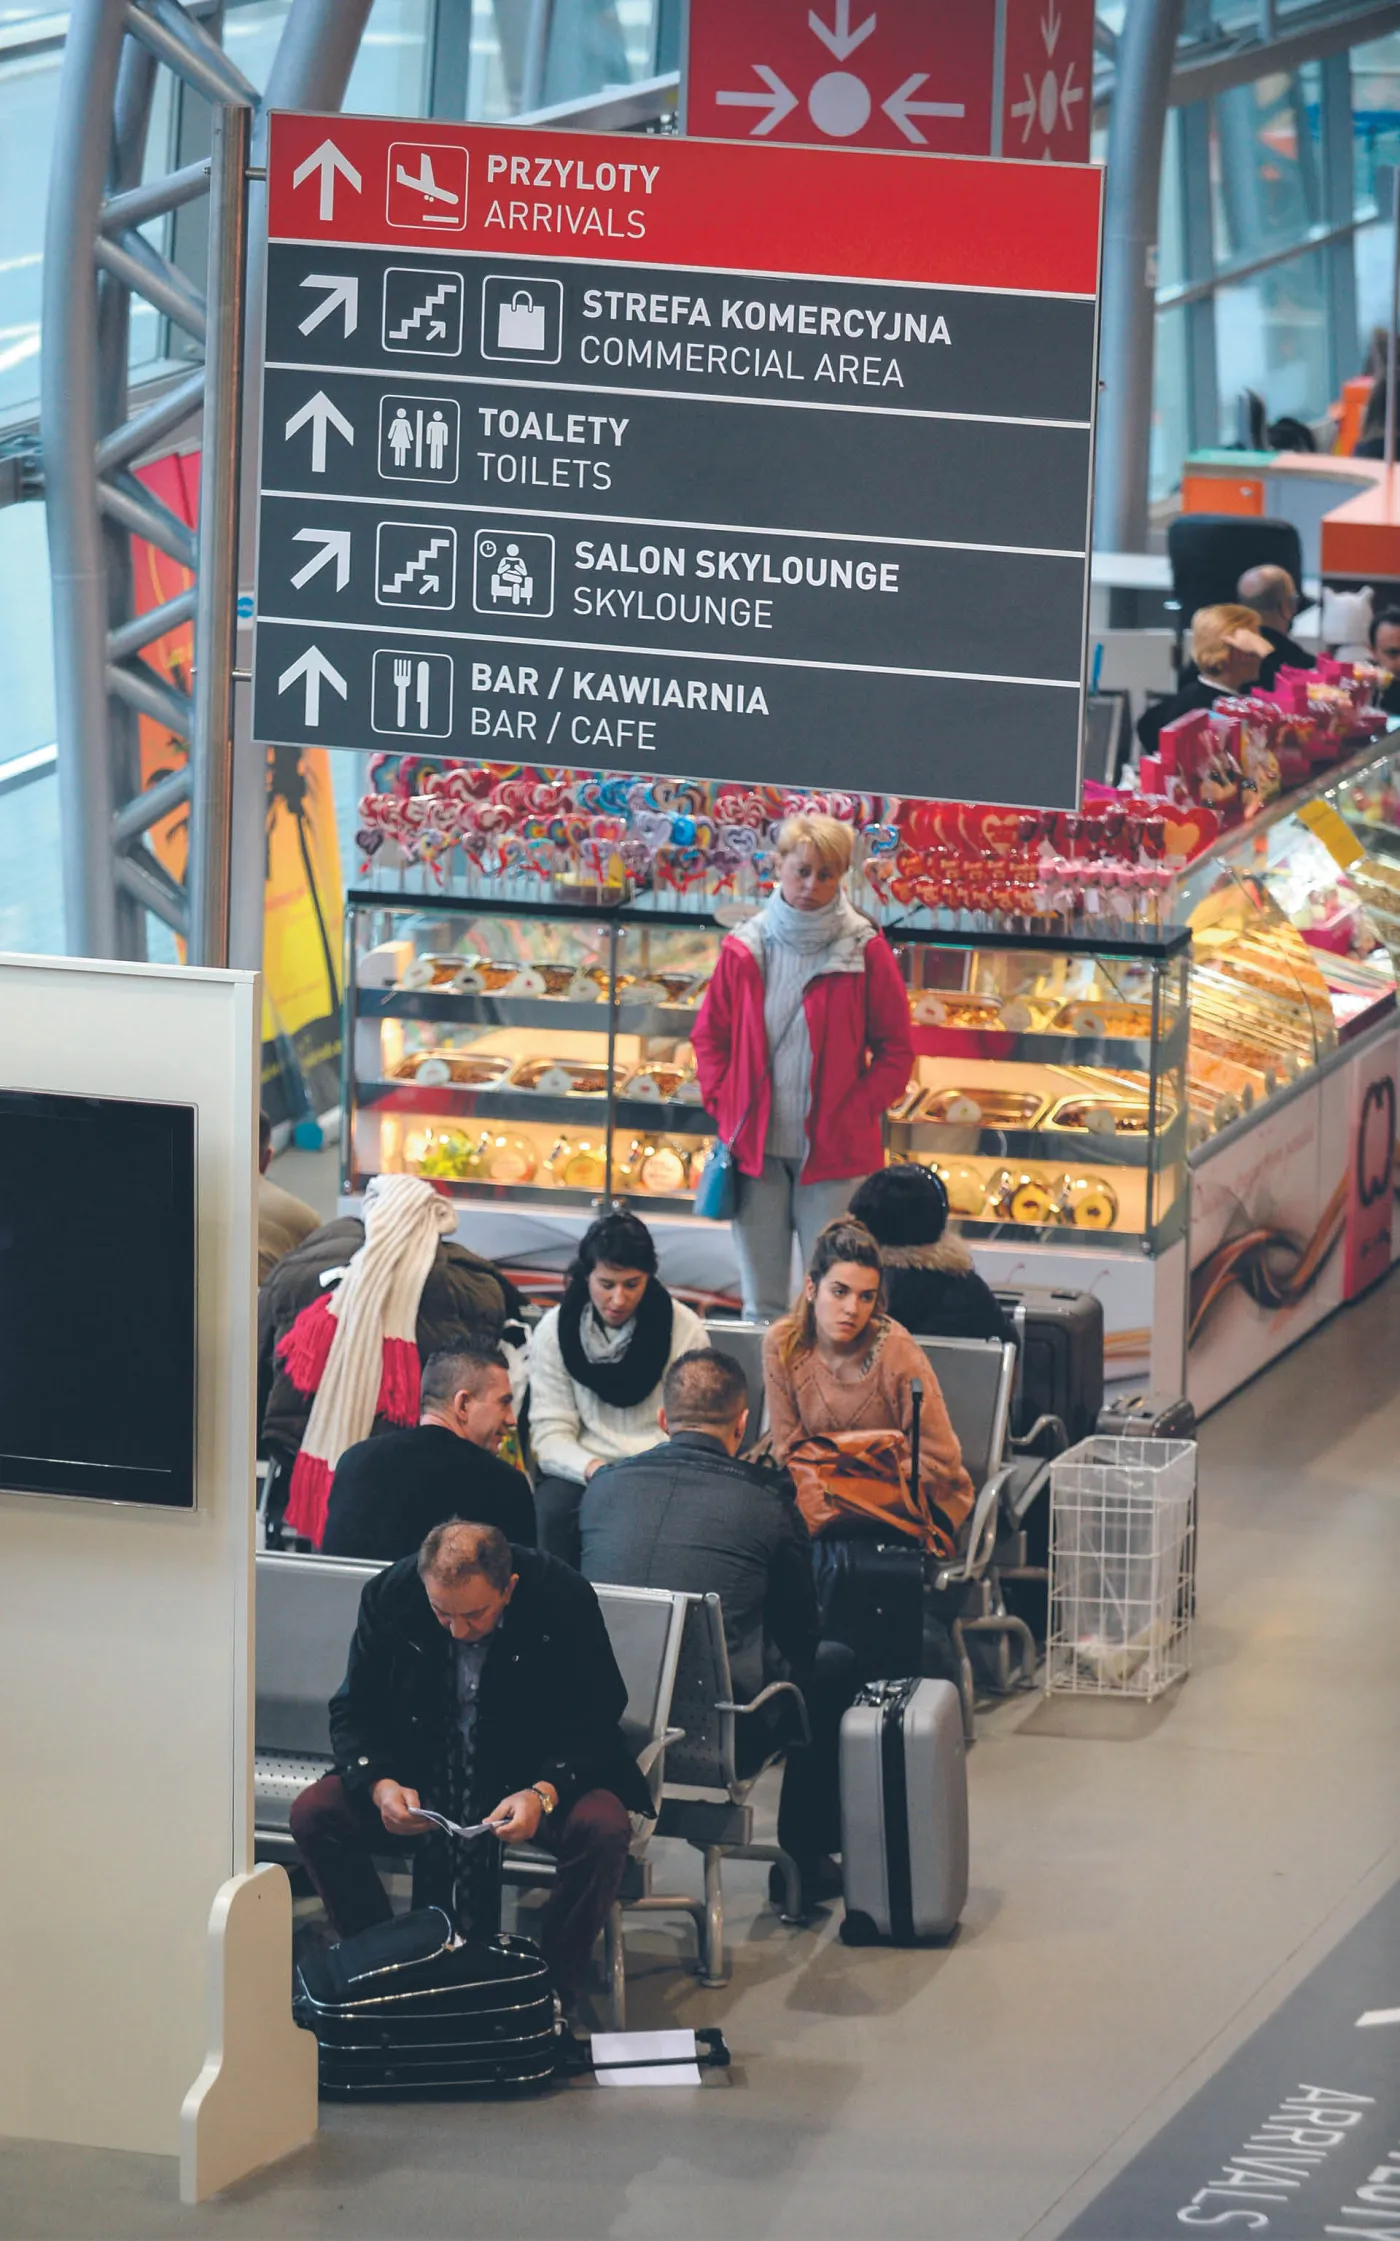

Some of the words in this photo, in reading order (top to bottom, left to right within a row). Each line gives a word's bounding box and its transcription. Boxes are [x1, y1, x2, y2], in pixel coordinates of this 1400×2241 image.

[487, 154, 660, 194] PRZYLOTY
[484, 200, 646, 239] ARRIVALS
[582, 289, 712, 327] STREFA
[721, 299, 952, 345] KOMERCYJNA
[580, 335, 805, 380] COMMERCIAL
[813, 353, 905, 388] AREA
[478, 407, 630, 447] TOALETY
[476, 452, 612, 490] TOILETS
[574, 540, 685, 577] SALON
[694, 549, 900, 593] SKYLOUNGE
[573, 586, 774, 629] SKYLOUNGE
[471, 662, 539, 696] BAR
[547, 666, 565, 700] /
[573, 671, 770, 716] KAWIARNIA
[471, 707, 537, 740] BAR
[546, 711, 562, 744] /
[571, 715, 657, 751] CAFE
[1176, 2083, 1376, 2228] ARRIVALS
